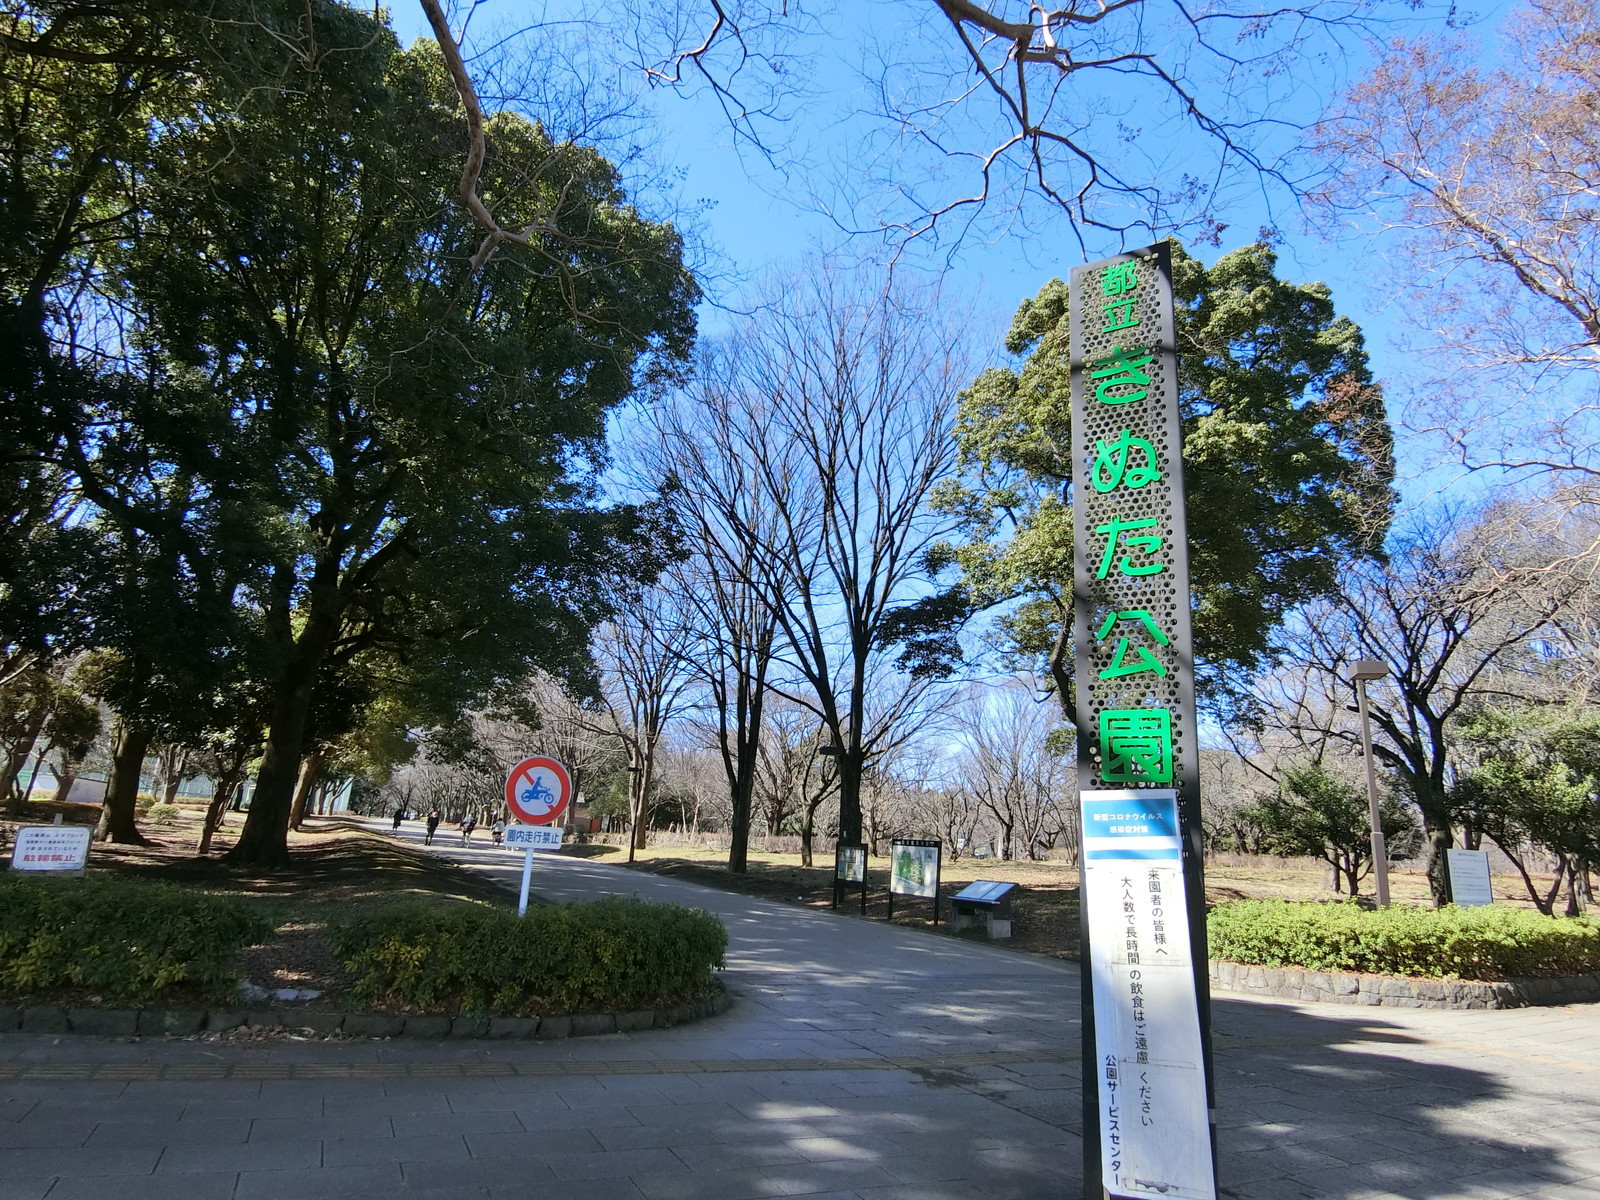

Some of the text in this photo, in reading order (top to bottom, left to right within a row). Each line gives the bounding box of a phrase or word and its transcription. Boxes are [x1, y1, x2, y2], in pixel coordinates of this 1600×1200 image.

[507, 829, 559, 844] 園内走行禁止
[1148, 868, 1168, 956] 来園者の皆様へ
[1104, 1054, 1122, 1187] 公園サービスセンター
